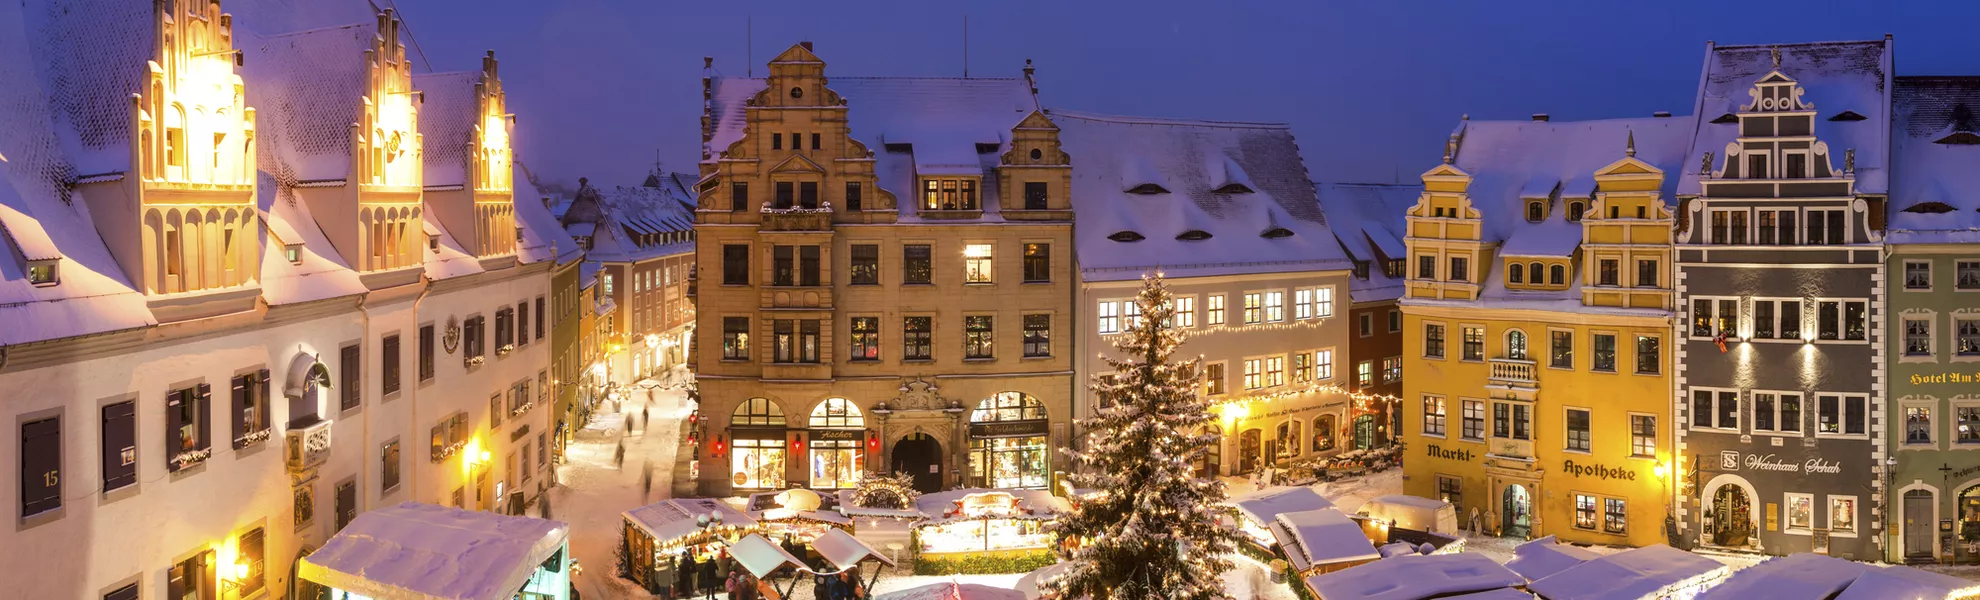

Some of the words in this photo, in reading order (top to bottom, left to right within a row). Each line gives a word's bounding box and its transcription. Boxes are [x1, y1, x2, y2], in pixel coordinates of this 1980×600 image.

[1909, 373, 1946, 385] Hotel
[1949, 372, 1972, 383] Am
[121, 449, 135, 465] 14
[1427, 444, 1475, 461] Markt-
[1563, 459, 1636, 481] Apotheke
[1744, 453, 1800, 473] Weinhaus
[1804, 457, 1841, 475] Schuh
[44, 470, 58, 487] 15
